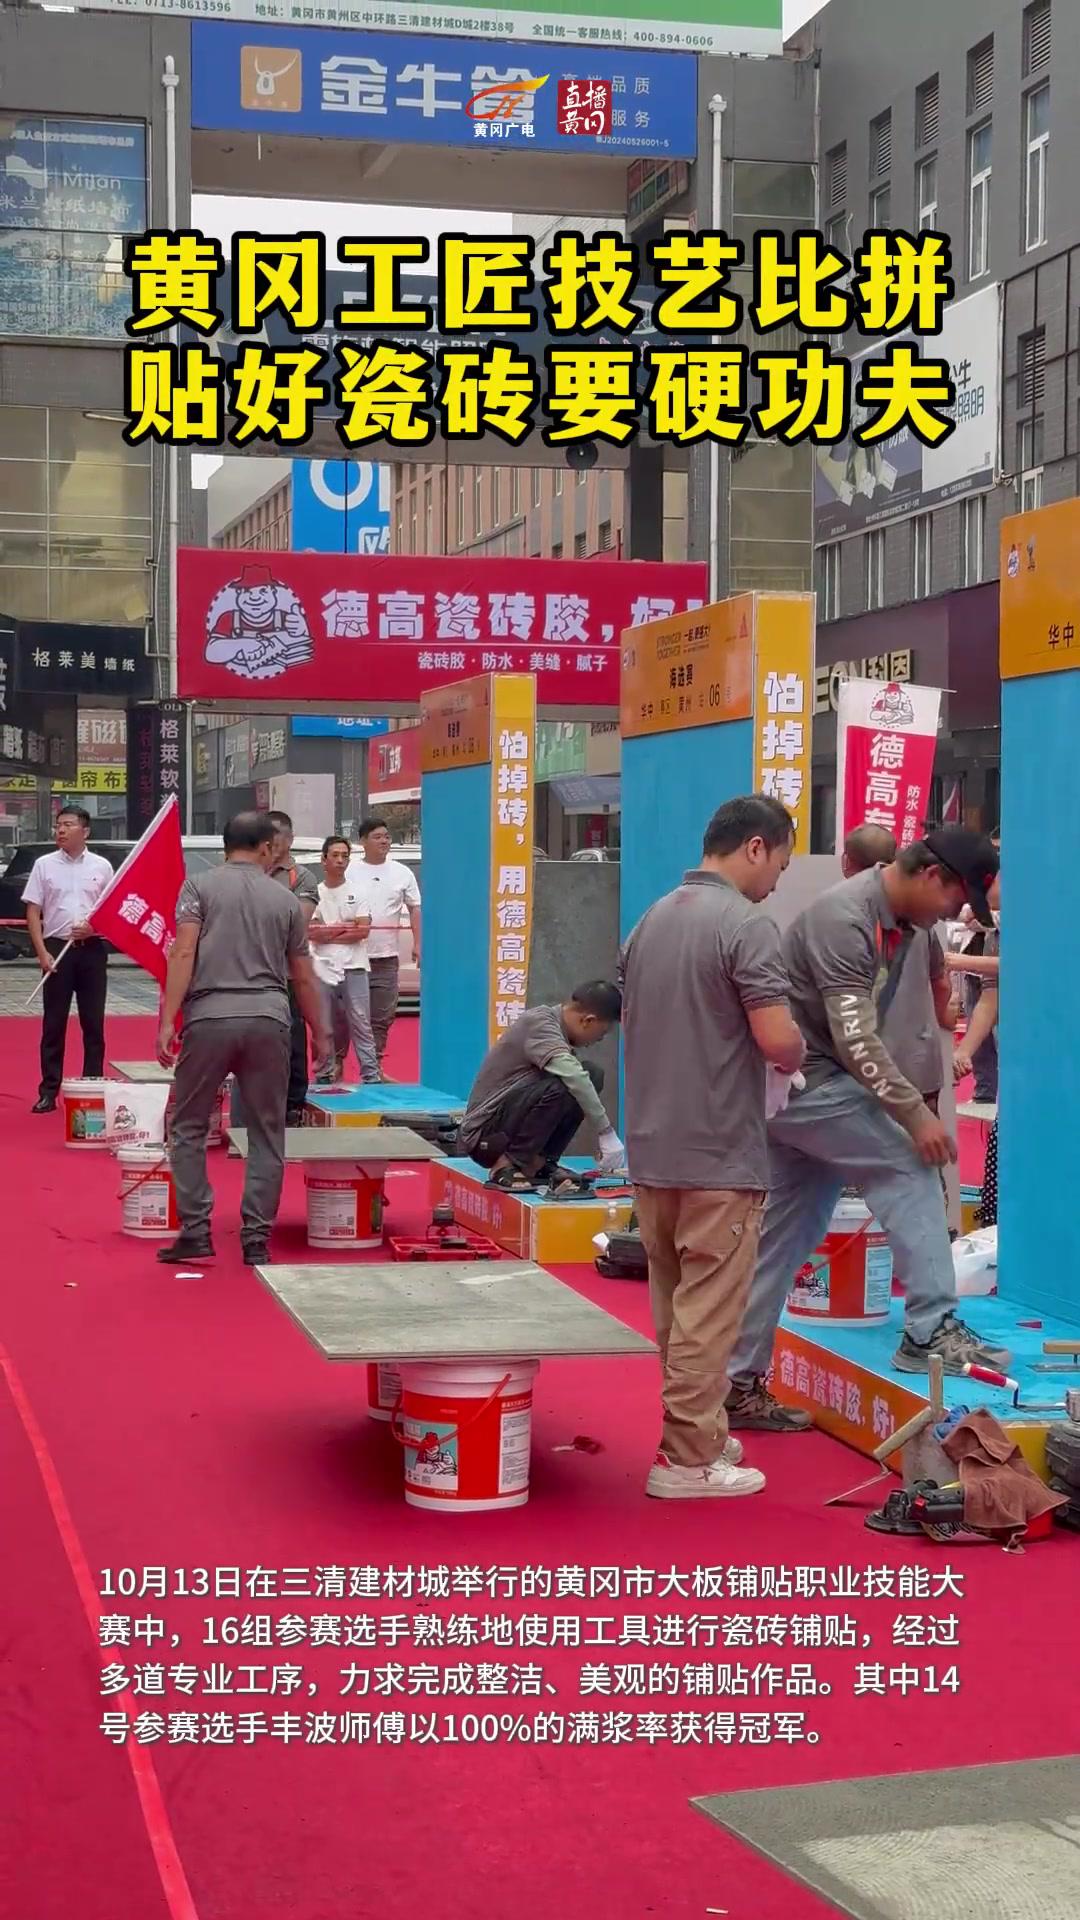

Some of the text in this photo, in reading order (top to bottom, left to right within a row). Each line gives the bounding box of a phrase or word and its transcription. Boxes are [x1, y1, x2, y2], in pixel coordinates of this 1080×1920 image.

[1048, 622, 1075, 650] 华中
[709, 683, 720, 707] 06
[496, 730, 529, 1041] 怕掉砖，用德高瓷砖
[117, 893, 177, 959] 德高
